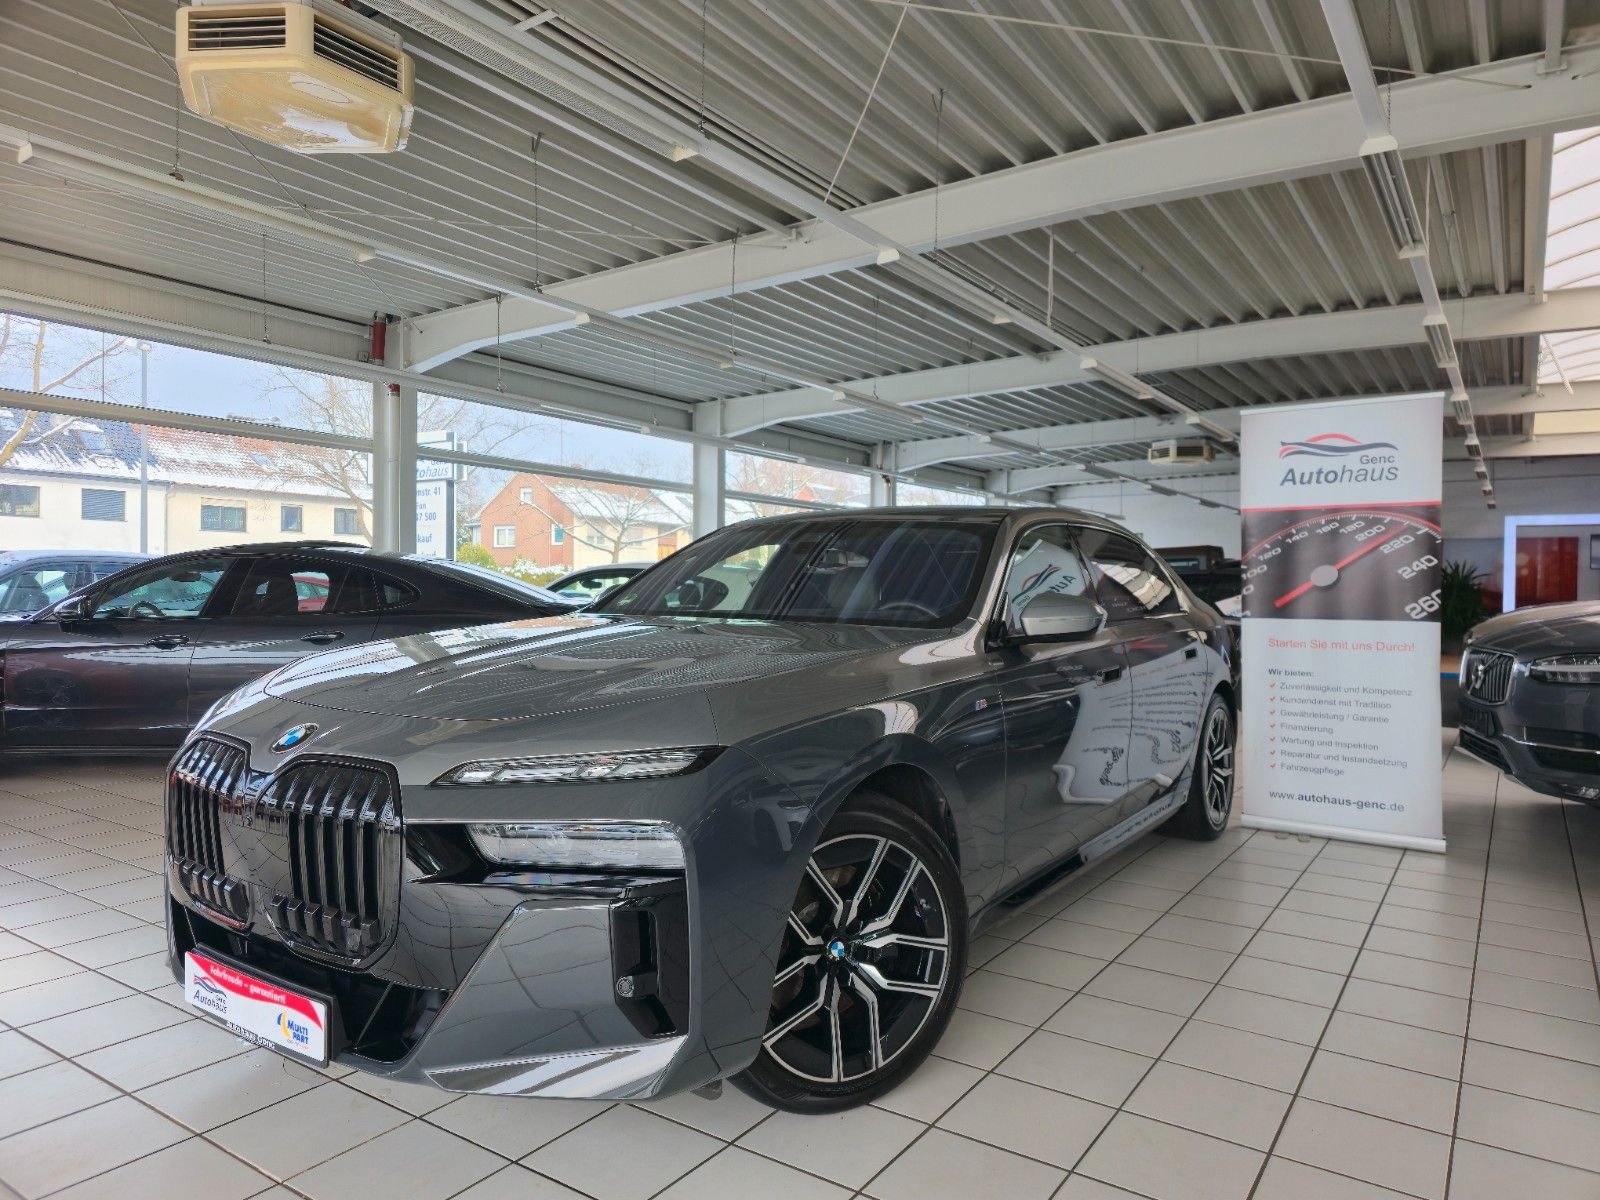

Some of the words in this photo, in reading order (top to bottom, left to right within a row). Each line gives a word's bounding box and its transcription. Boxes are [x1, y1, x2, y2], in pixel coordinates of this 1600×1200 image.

[1359, 454, 1395, 465] Genc
[1279, 464, 1399, 487] Autohaus
[424, 511, 437, 522] 500
[416, 533, 433, 543] kauf
[1285, 530, 1309, 544] 140
[1354, 524, 1386, 542] 200
[1379, 534, 1416, 554] 220
[1257, 547, 1282, 562] 120
[1240, 564, 1268, 580] 100
[1397, 554, 1439, 580] 240
[1267, 637, 1307, 649] Starten
[1309, 638, 1328, 650] Sie
[1331, 640, 1348, 651] mit
[1351, 642, 1372, 652] uns
[1375, 641, 1415, 653] Durch!
[1267, 668, 1283, 676] Wir
[1284, 668, 1314, 678] bieten:
[1344, 685, 1360, 694] und
[1362, 686, 1414, 698] Kompetenz
[1279, 695, 1336, 706] Kundendienst
[1338, 698, 1352, 708] mit
[1354, 699, 1392, 710] Tradition
[1279, 709, 1345, 723] Gewährleistung
[1352, 713, 1390, 724] Garantie
[1280, 722, 1334, 735] Finanzierung
[1280, 736, 1315, 748] Wartung
[1316, 739, 1333, 748] und
[1334, 741, 1379, 752] Inspektion
[1280, 749, 1321, 761] Reparatur
[1323, 753, 1340, 762] und
[1341, 754, 1408, 769] Instandsetzung
[1280, 763, 1345, 777] Fahrzeugpflege
[1269, 790, 1405, 814] www.autohaus-genc.de
[193, 989, 228, 1014] Autohaus
[292, 1031, 309, 1045] PART
